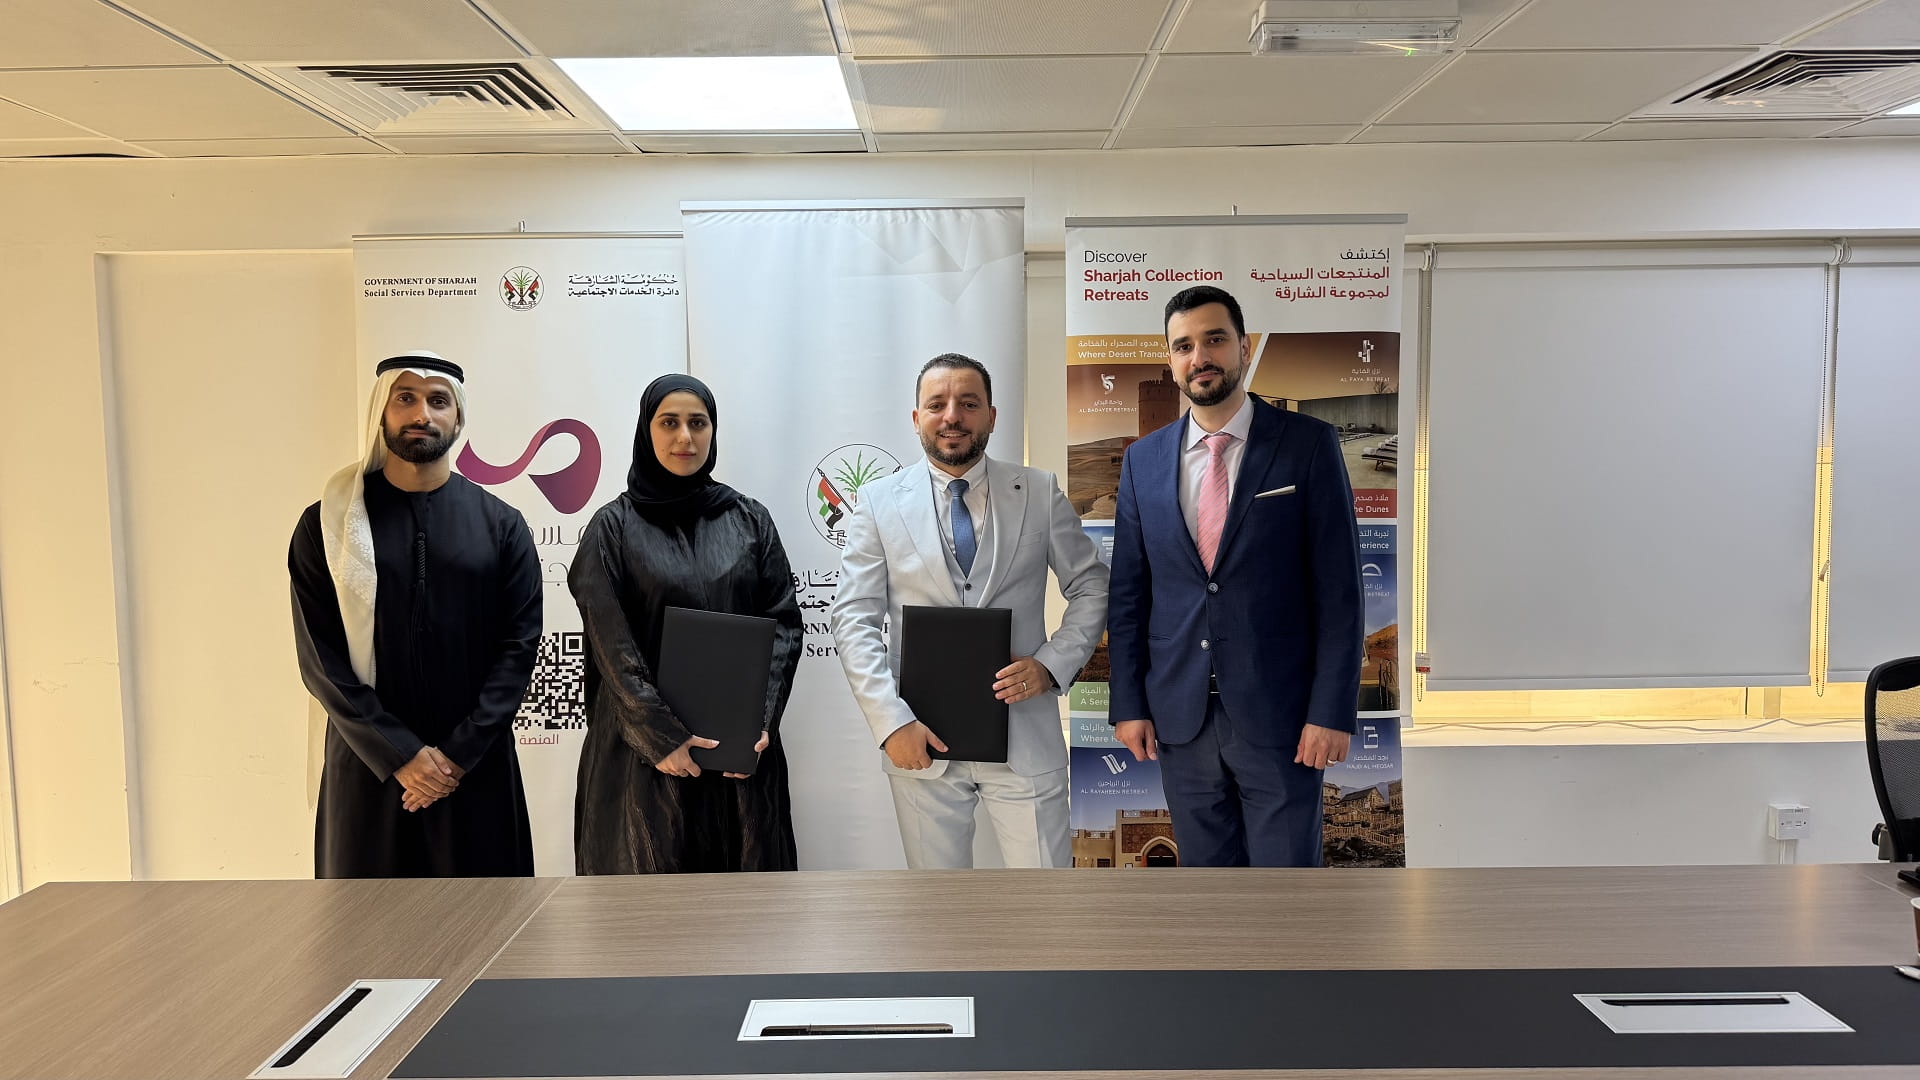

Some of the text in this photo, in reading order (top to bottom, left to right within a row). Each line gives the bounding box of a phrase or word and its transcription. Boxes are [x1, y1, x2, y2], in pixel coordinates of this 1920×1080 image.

[1084, 250, 1147, 263] Discover
[1340, 248, 1390, 263] إكتشف
[1084, 268, 1223, 284] Sharjah Collection
[1250, 266, 1390, 282] المنتجعات السياحية
[364, 277, 477, 286] GOVERNMENT OF SHARJAH
[364, 288, 477, 298] Social Services Department
[568, 287, 680, 298] دائرة الخدمات الاجتماعية
[1084, 289, 1149, 301] Retreats
[1275, 285, 1390, 302] لمجموعة الشارقة
[1140, 341, 1159, 349] هدوء
[1078, 351, 1106, 359] Where
[1108, 350, 1136, 358] Desert
[1365, 505, 1389, 513] Dunes
[1080, 697, 1087, 705] A
[519, 734, 559, 745] المنصة
[1080, 734, 1109, 743] Where
